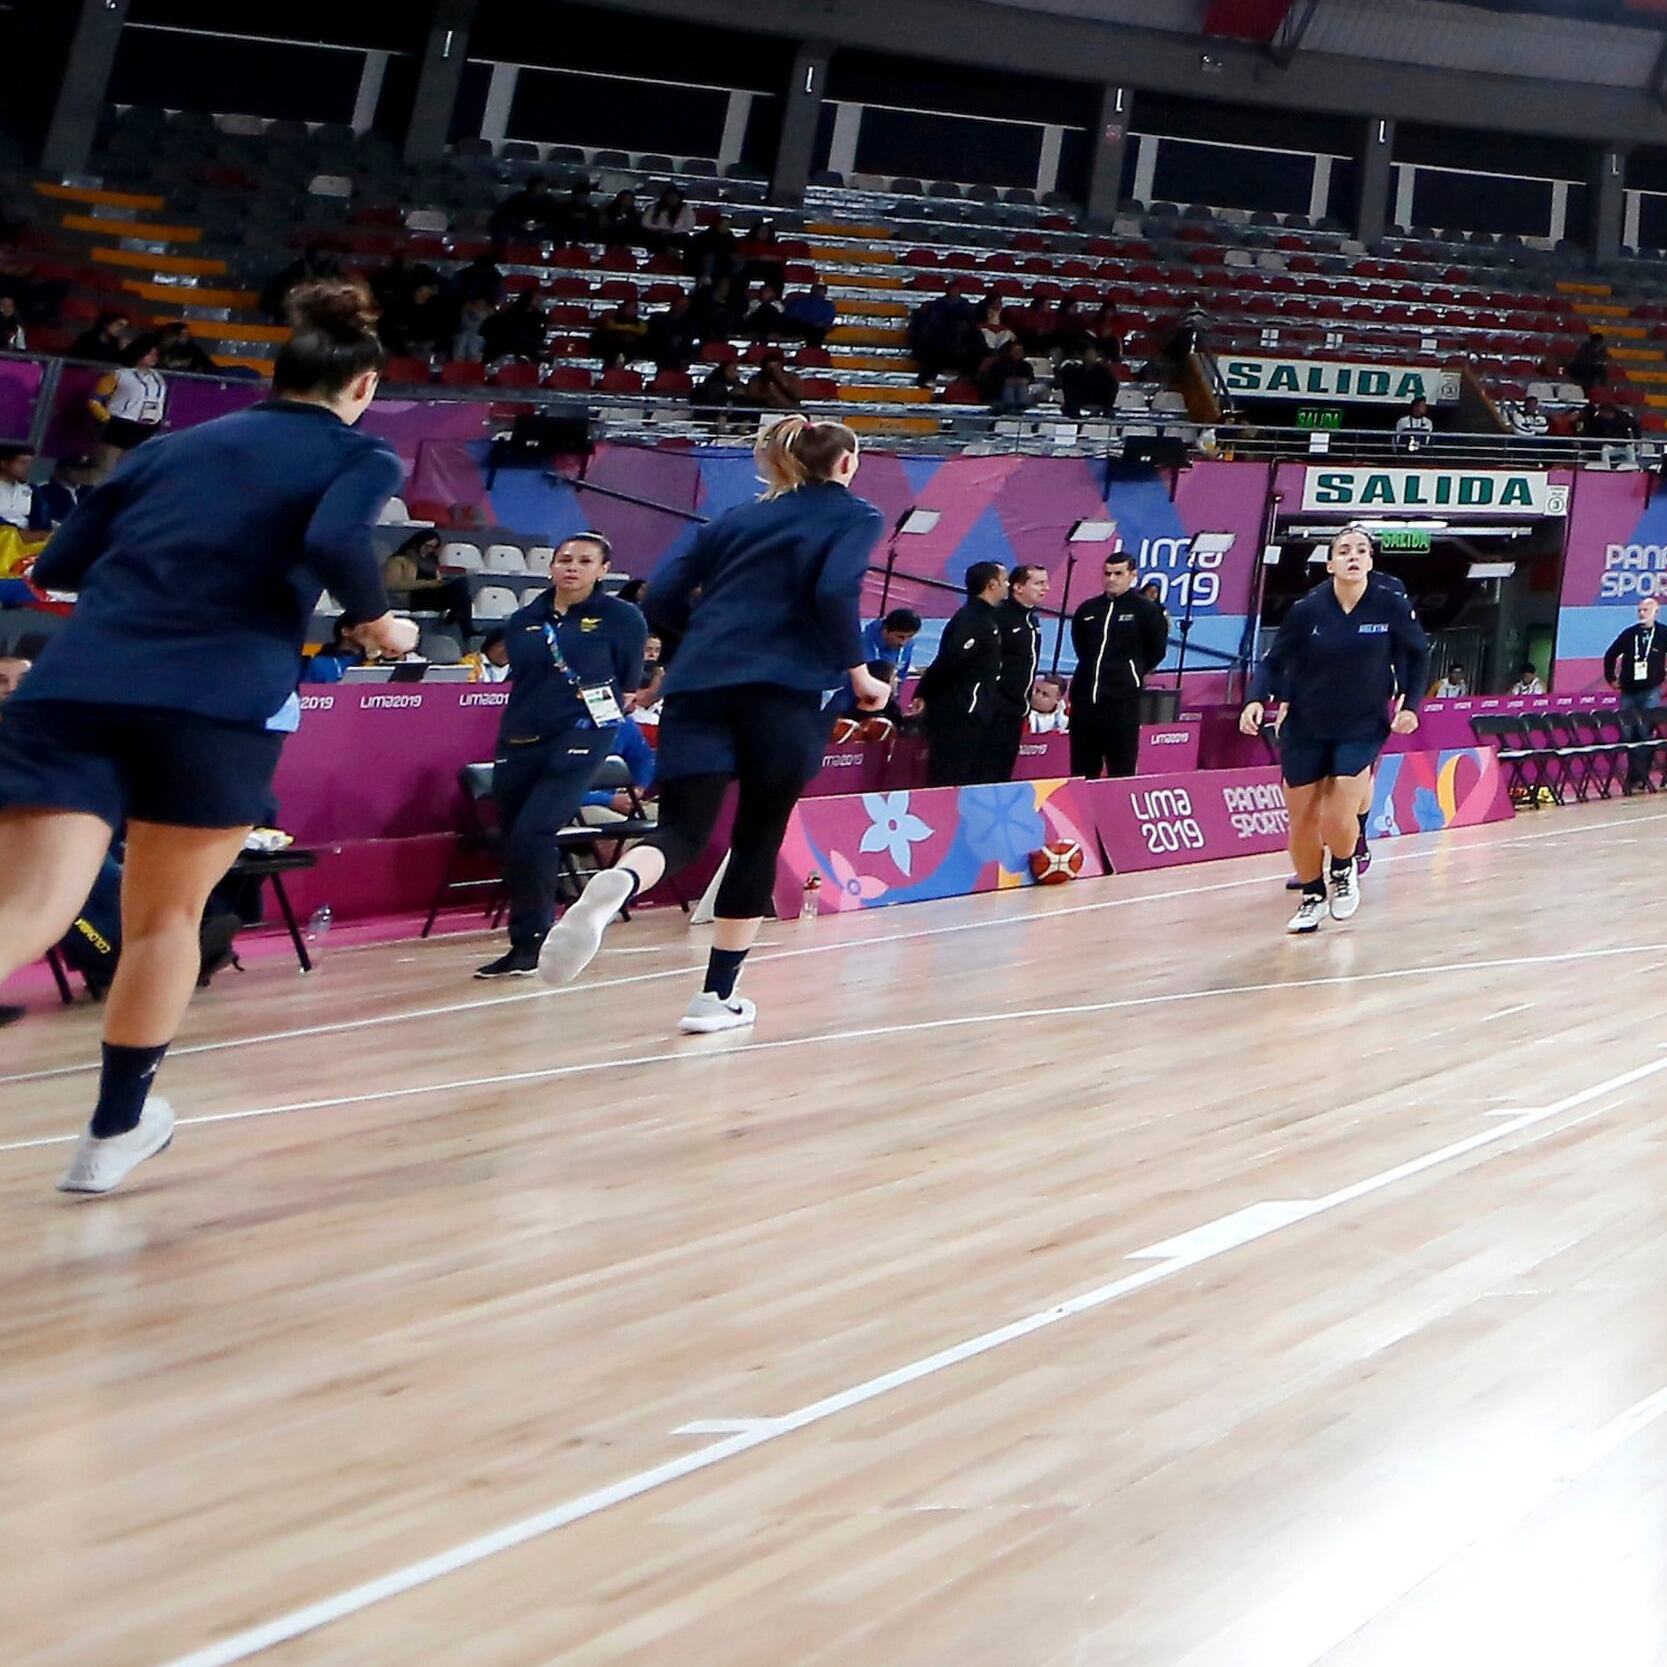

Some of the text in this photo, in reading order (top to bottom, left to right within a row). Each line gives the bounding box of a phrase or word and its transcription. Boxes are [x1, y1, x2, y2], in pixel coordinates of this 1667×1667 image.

[1227, 362, 1427, 398] SALIDA
[1299, 411, 1341, 428] SALIDA
[1315, 473, 1534, 506] SALIDA
[1382, 533, 1430, 549] SALIDA
[1131, 571, 1221, 607] 019
[1141, 818, 1205, 854] 2019
